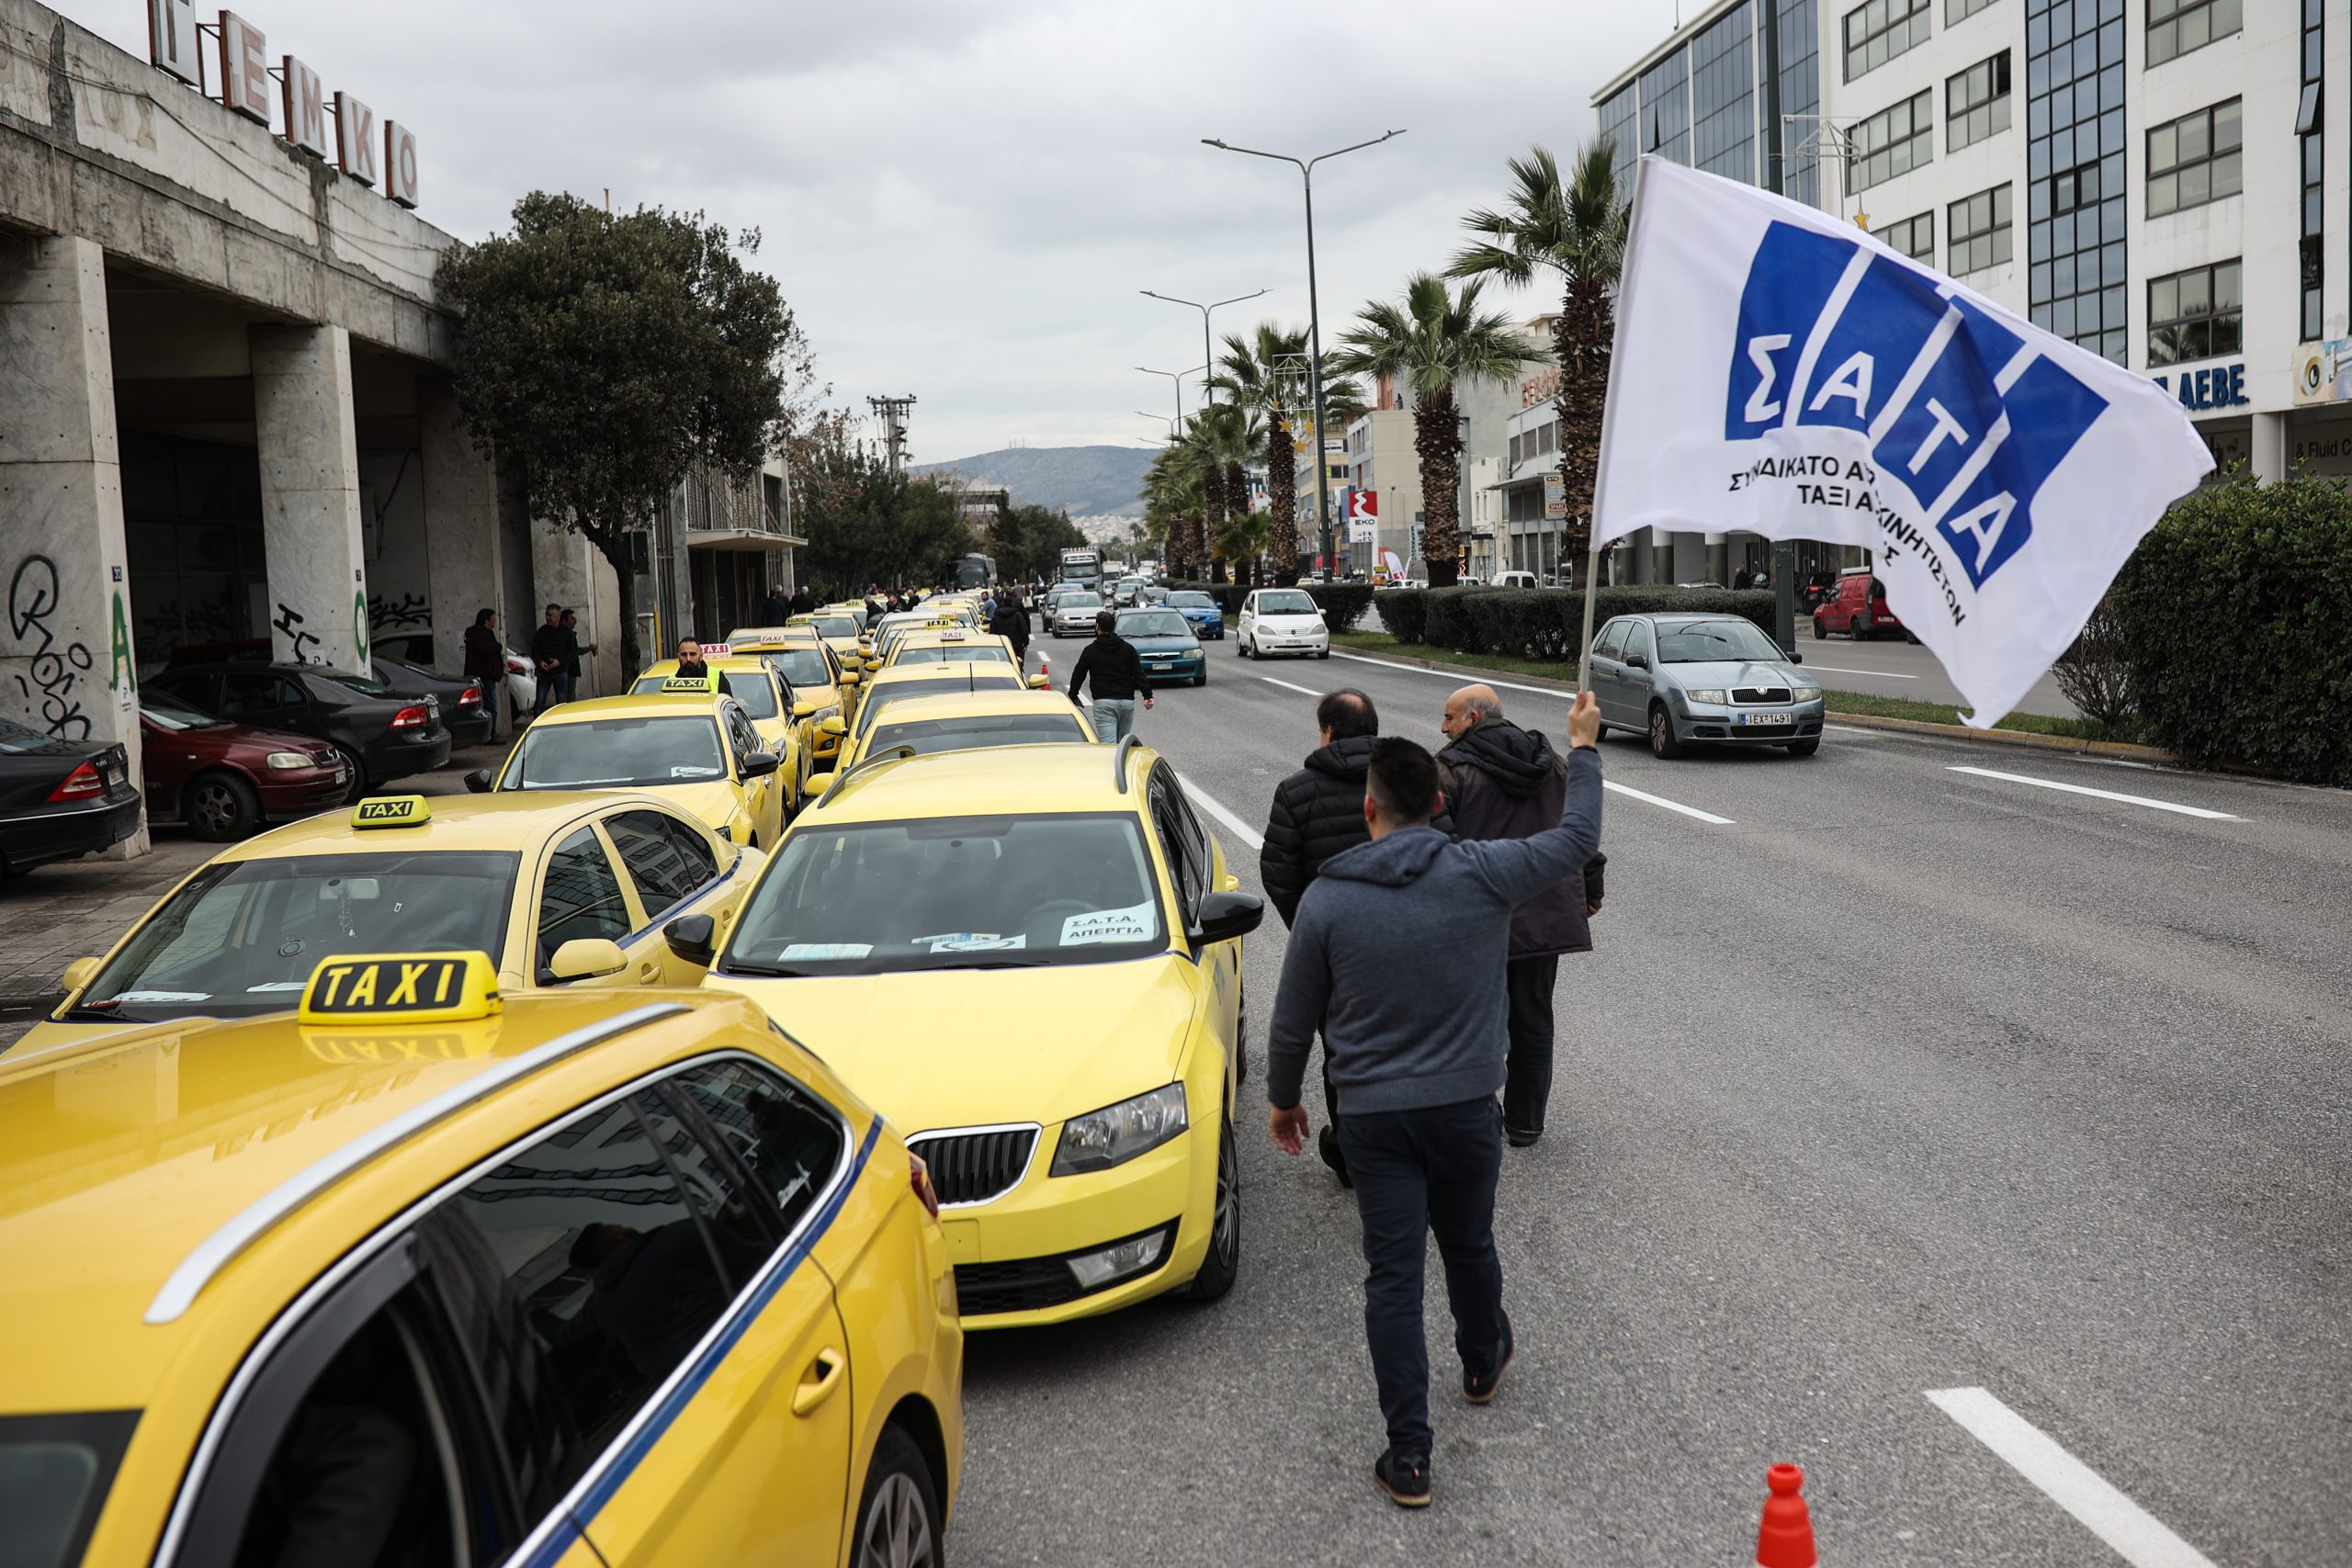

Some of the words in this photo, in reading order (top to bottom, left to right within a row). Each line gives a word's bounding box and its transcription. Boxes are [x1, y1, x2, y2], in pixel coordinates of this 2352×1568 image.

[2308, 439, 2337, 458] Fluid
[1729, 456, 1839, 491] ΣΥΝΔΙΚΑΤΟ
[1797, 484, 1850, 508] ΤΑΞΙ
[668, 679, 704, 687] TAXI
[364, 802, 413, 817] TAXI
[1072, 915, 1136, 927] Σ.Α.Τ.Α.
[1069, 927, 1144, 938] ΑΠΕΡΓΙΑ
[324, 964, 454, 1007] TAXI
